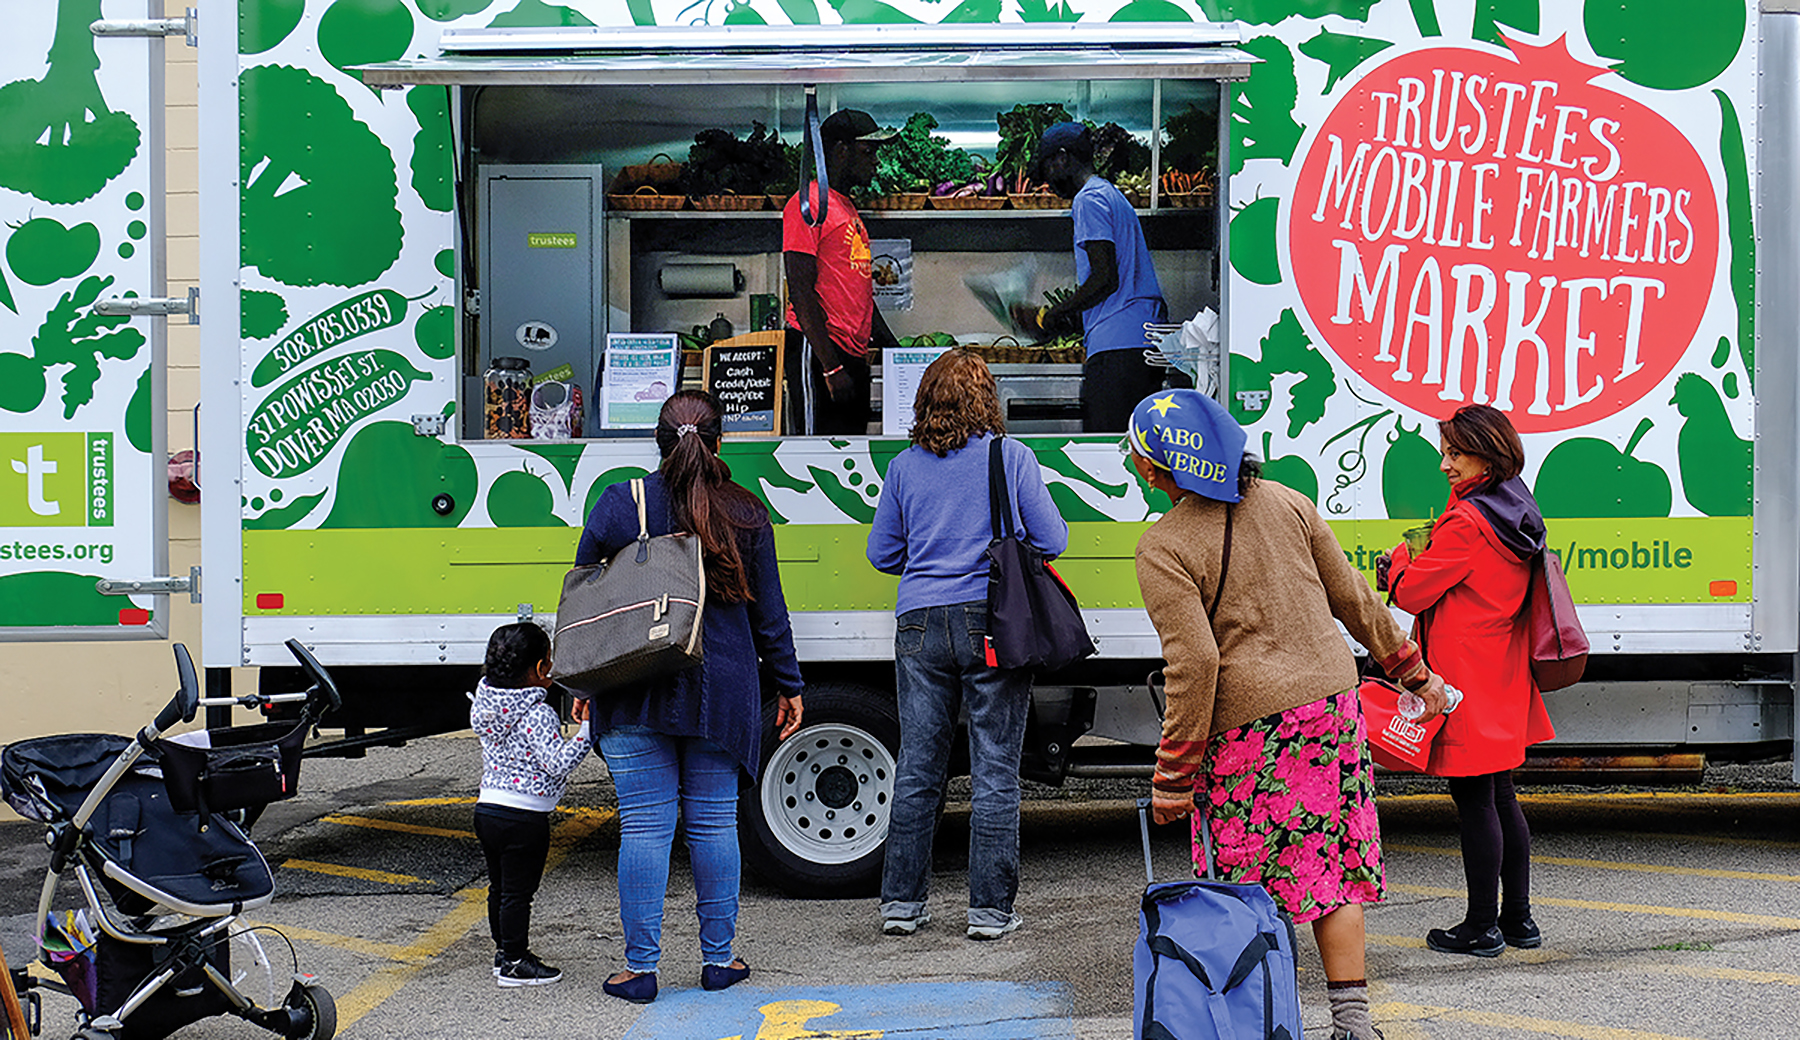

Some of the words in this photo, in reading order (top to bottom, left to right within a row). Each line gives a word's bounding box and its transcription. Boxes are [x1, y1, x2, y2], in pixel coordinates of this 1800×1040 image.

[1371, 69, 1621, 181] TRUSTEES
[530, 236, 575, 246] trustees
[1312, 134, 1499, 250] MOBILE
[1509, 166, 1694, 265] FARMERS
[273, 293, 392, 372] 508.785.0339
[1330, 239, 1665, 416] MARKET
[249, 412, 277, 444] 37
[357, 352, 385, 376] ST.
[254, 417, 339, 478] DOVER,
[321, 399, 359, 432] MA
[353, 370, 407, 411] 02030
[92, 438, 109, 520] trustees
[0, 541, 114, 564] stees.org
